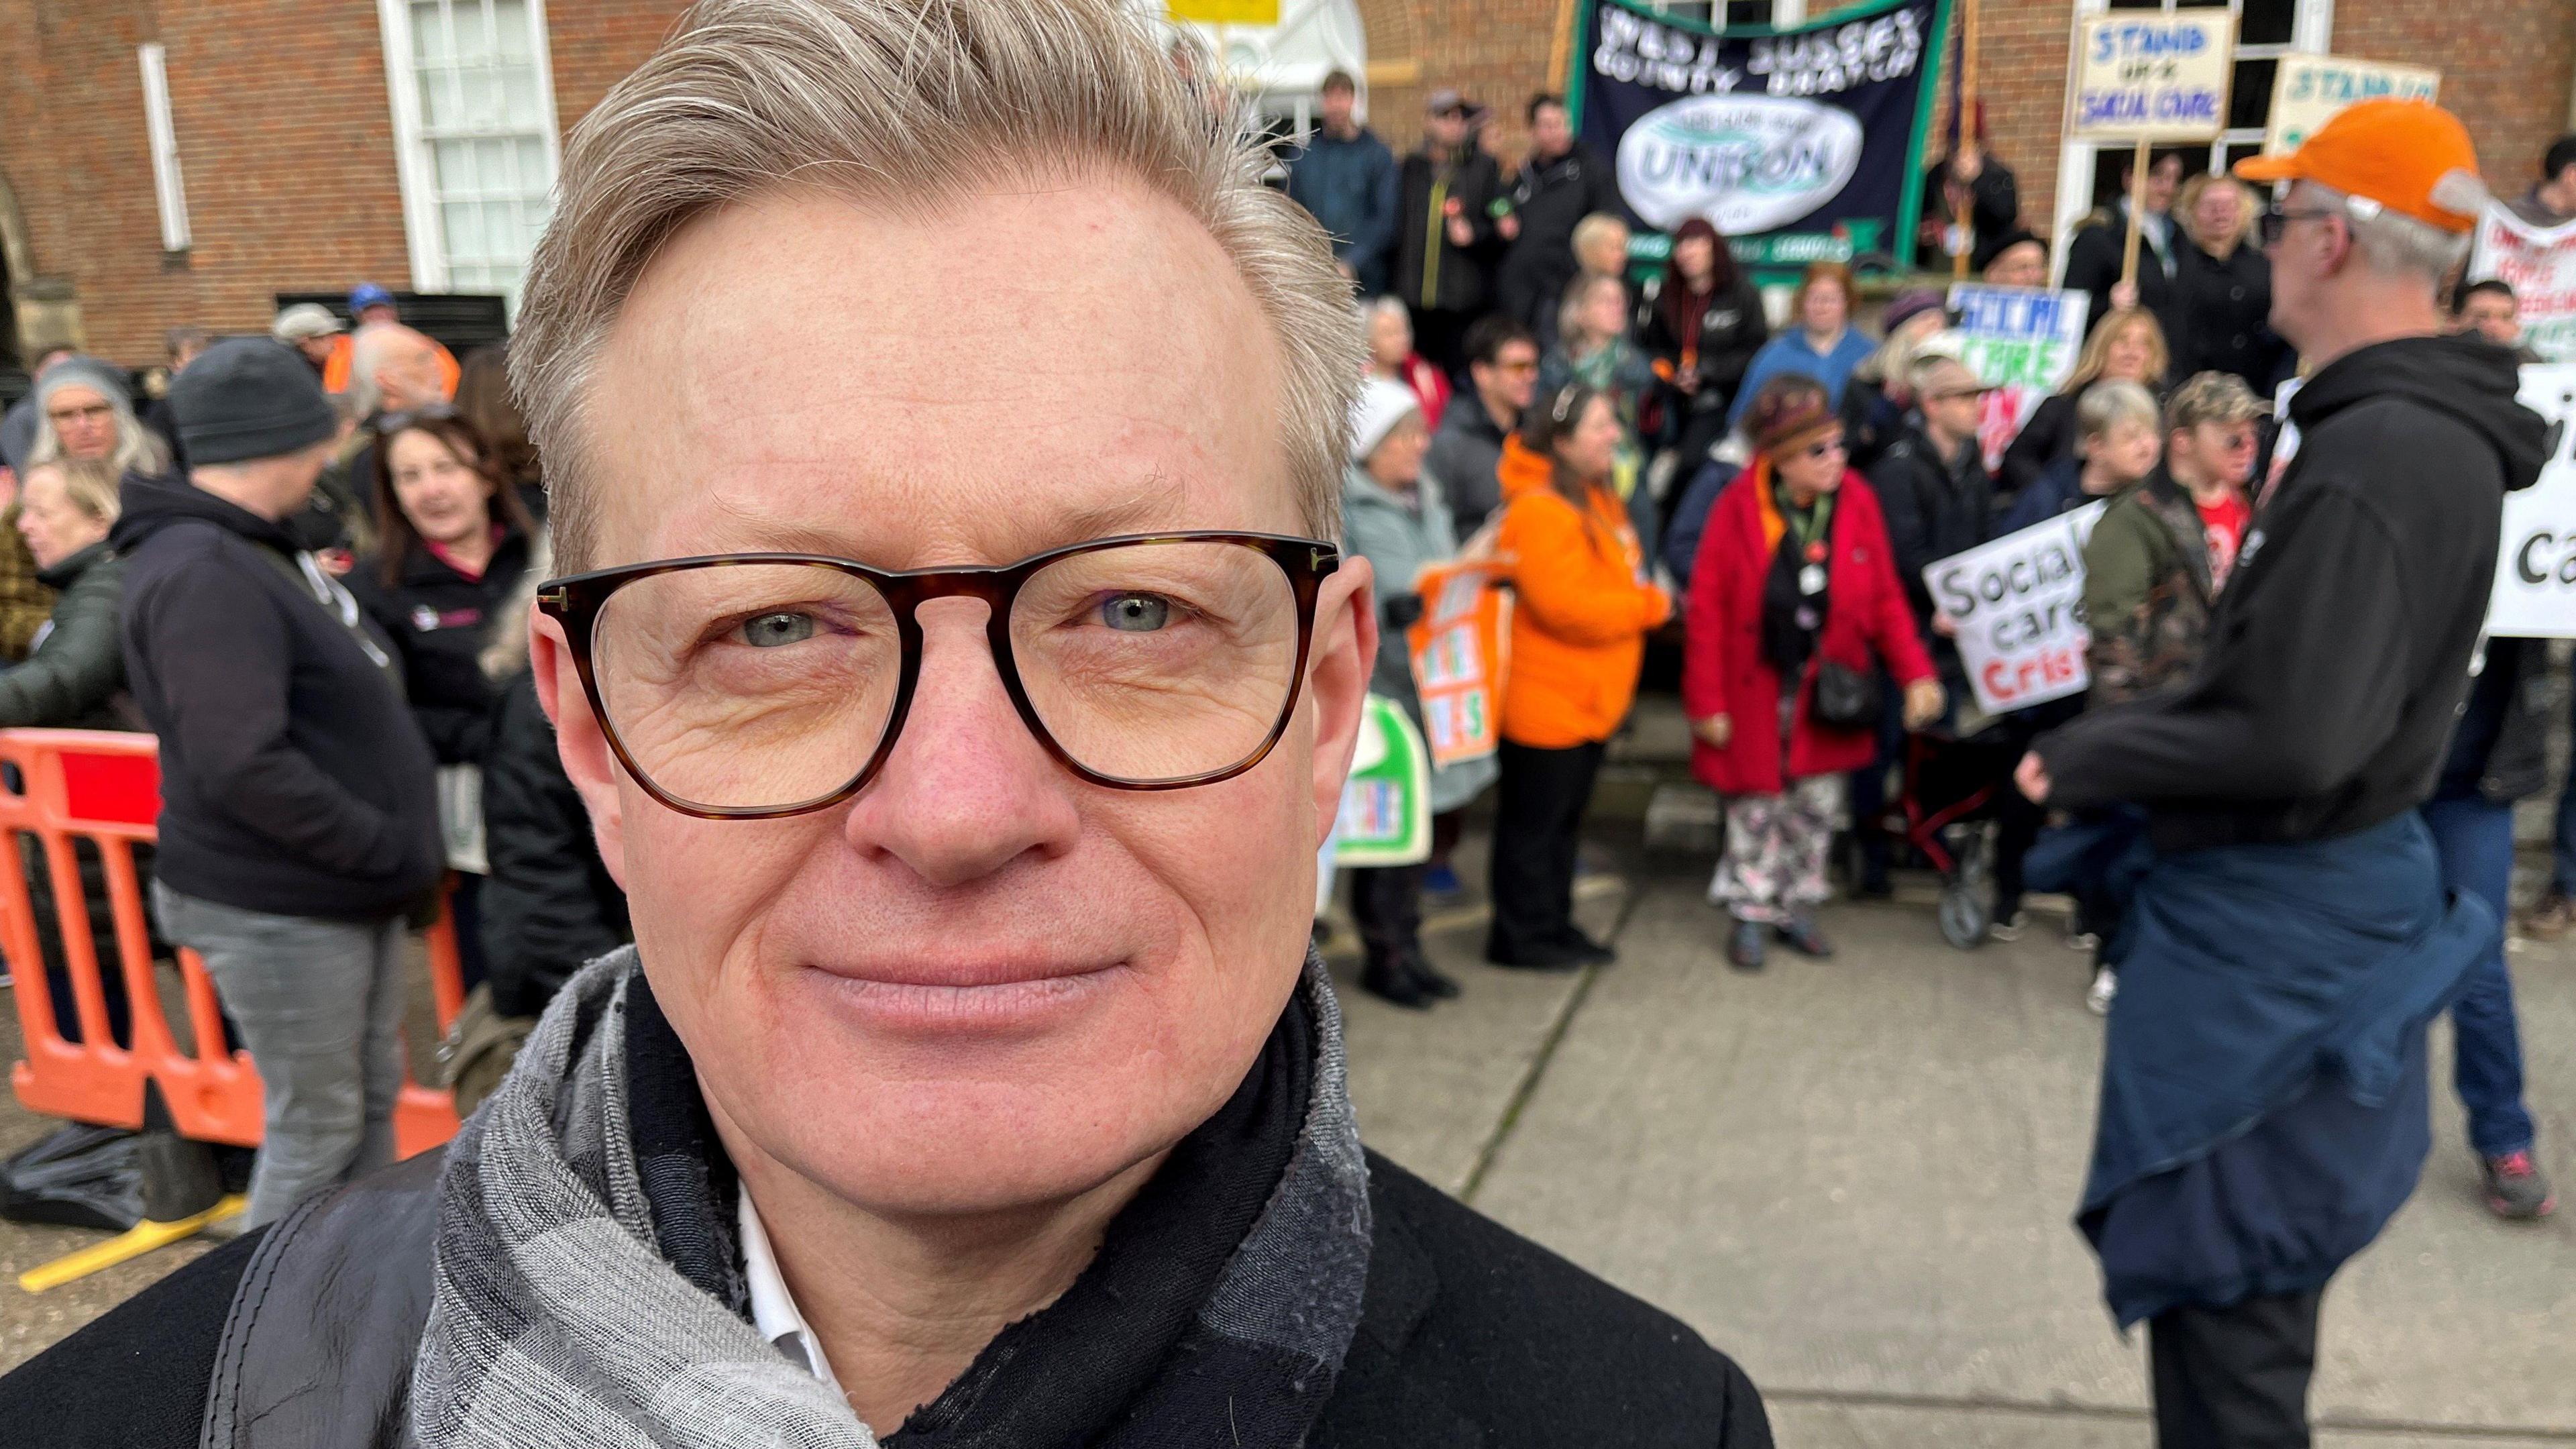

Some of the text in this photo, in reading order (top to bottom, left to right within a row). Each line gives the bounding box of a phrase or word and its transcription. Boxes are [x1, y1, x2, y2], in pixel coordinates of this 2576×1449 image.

[2094, 25, 2206, 62] STAND
[1643, 136, 1830, 186] UNISON
[1941, 515, 2082, 619] Social
[1984, 647, 2076, 700] Cris
